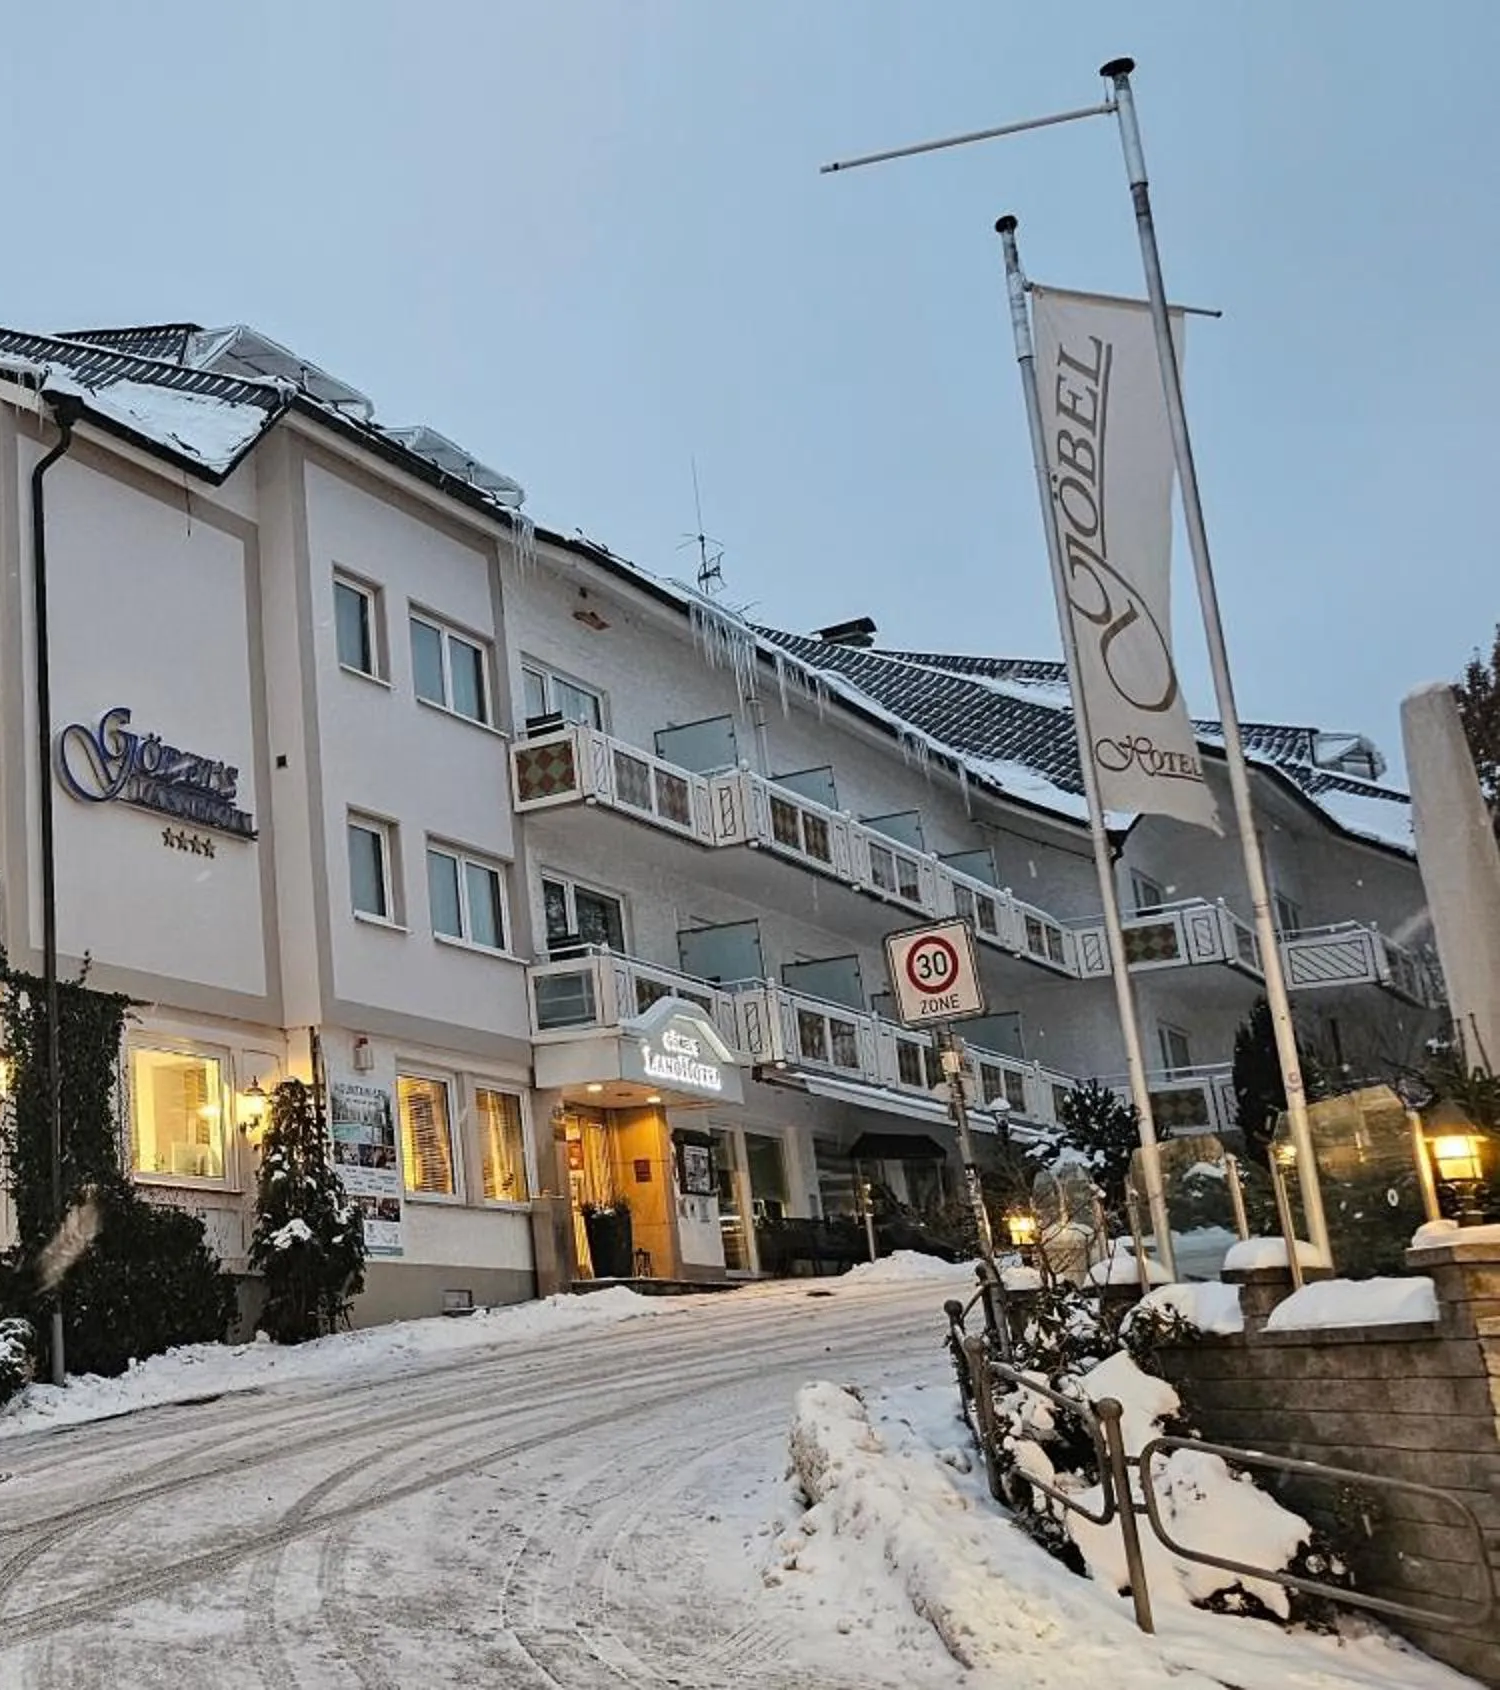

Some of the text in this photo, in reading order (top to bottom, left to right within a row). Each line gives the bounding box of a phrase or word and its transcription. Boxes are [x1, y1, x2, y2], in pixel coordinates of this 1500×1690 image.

[1054, 334, 1178, 713] GÖBEL
[1096, 735, 1203, 777] HOTEL
[916, 951, 948, 979] 30
[920, 993, 960, 1015] ZONE
